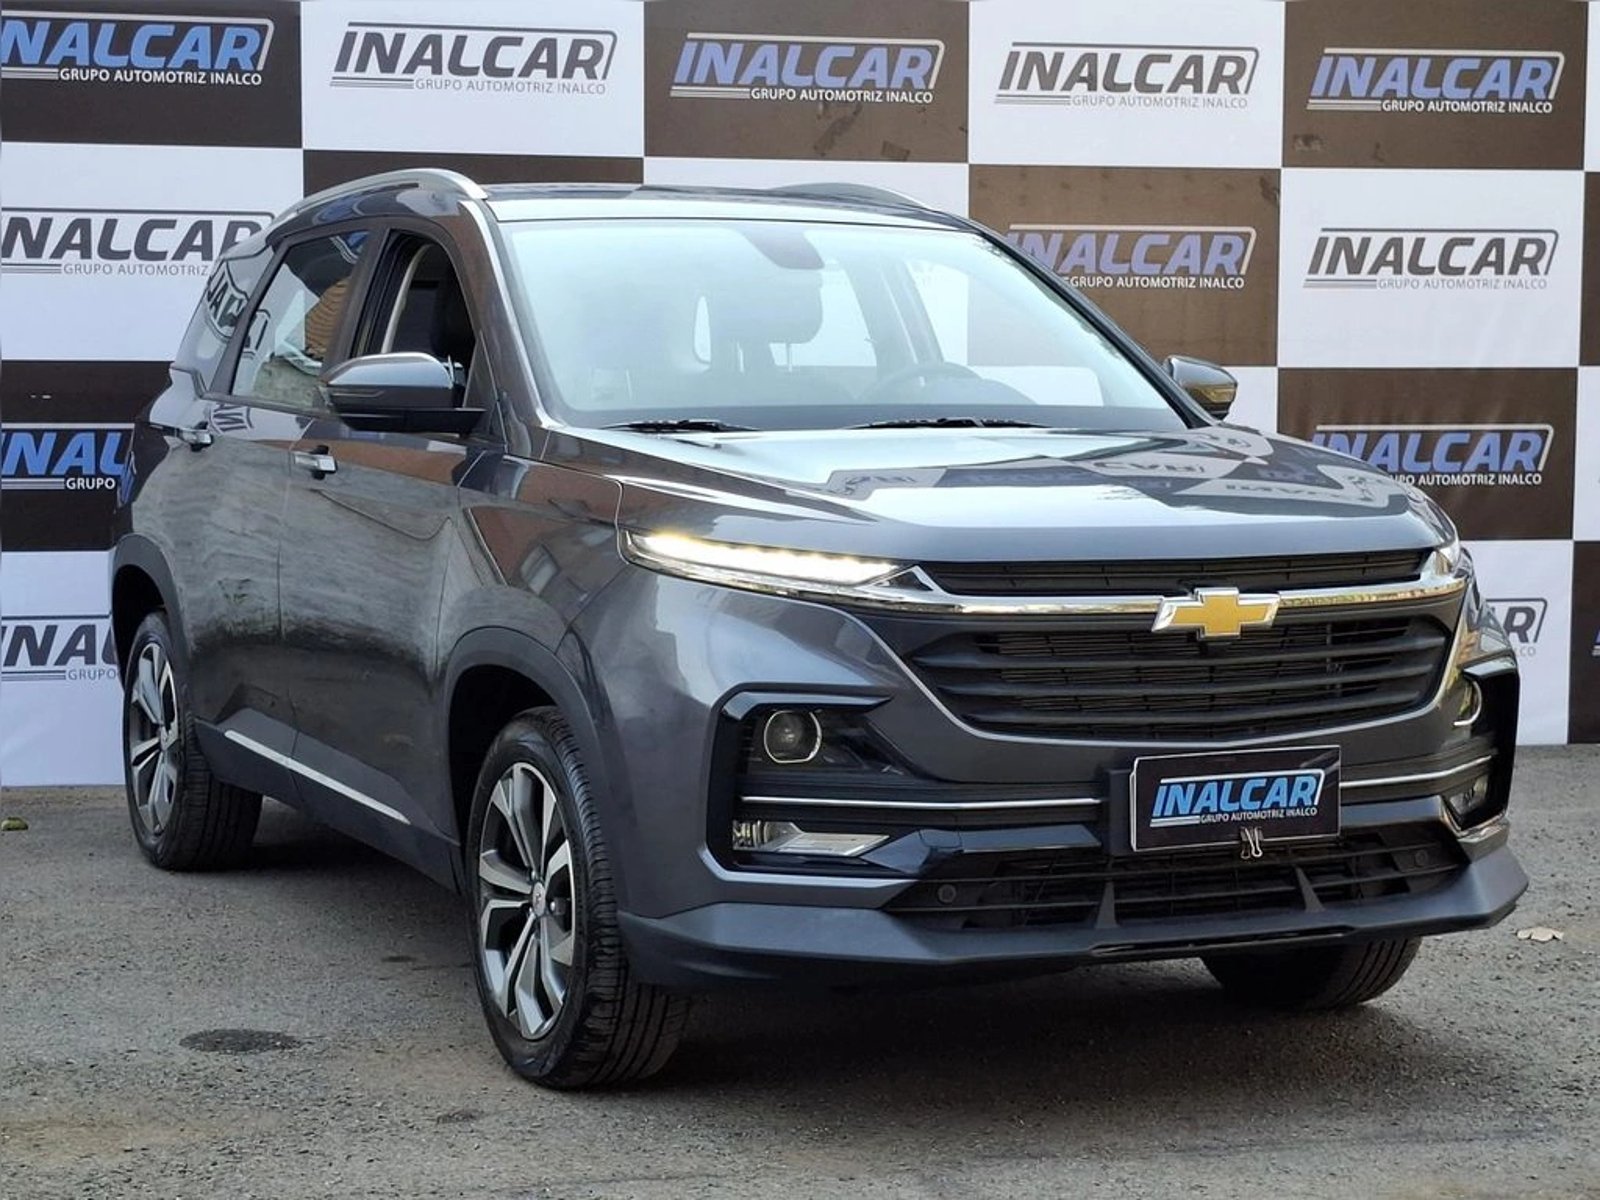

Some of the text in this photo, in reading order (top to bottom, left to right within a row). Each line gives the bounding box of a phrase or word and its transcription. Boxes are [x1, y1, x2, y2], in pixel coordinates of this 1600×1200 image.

[334, 31, 604, 80] INALCAR
[674, 41, 932, 89] INALCAR
[999, 51, 1247, 94] INALCAR
[60, 68, 262, 85] GRUPO AUTOMOTRIZ INALCO
[1311, 56, 1552, 100] INALCAR
[415, 79, 606, 95] GRUPO AUTOMOTRIZ INALCO
[751, 87, 933, 103] GRUPO AUTOMOTRIZ INALCO
[1072, 95, 1248, 109] GRUPO AUTOMOTRIZ INALCO
[1382, 100, 1552, 113] GRUPO AUTOMOTRIZ INALCO
[1003, 232, 1245, 275] NALCAR
[1308, 236, 1547, 276] INALCAR
[64, 263, 209, 276] GRUPO AUTOMOTRIZ
[1070, 276, 1245, 289] GRUPO AUTOMOTRIZ INALCO
[1380, 279, 1547, 290] GRUPO AUTOMOTRIZ INALCO
[66, 477, 116, 489] GRUPO
[1419, 473, 1495, 486] AUTOMOTRIZ
[1499, 473, 1542, 485] INALCO
[68, 668, 117, 680] GRUPO
[1152, 775, 1317, 817] INALCAR
[1201, 807, 1317, 823] GRUPO AUTOMOTRIZ INALCO
